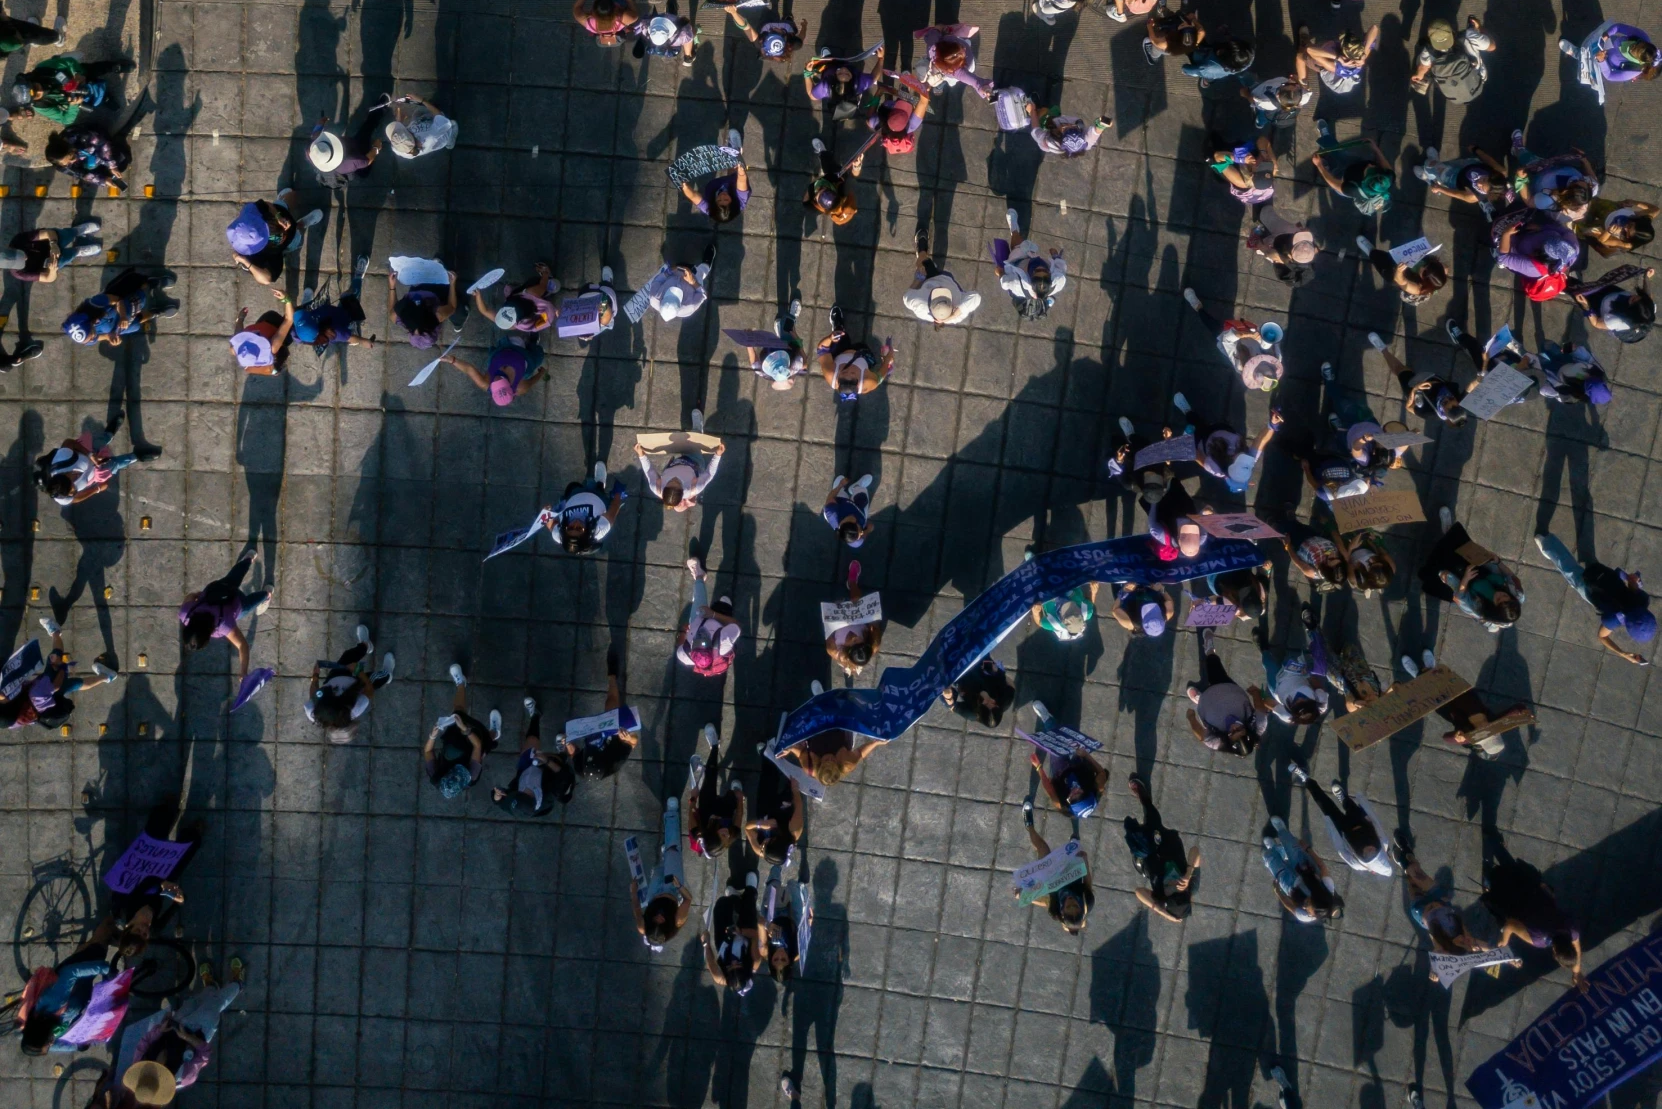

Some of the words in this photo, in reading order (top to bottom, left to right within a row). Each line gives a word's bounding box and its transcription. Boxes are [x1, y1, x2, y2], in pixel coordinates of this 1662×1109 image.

[124, 852, 172, 874] LIBRES
[1504, 938, 1662, 1074] MINICIDA
[1631, 987, 1662, 1021] EN
[1605, 1007, 1638, 1039] UN
[1568, 1049, 1627, 1099] ESTOY
